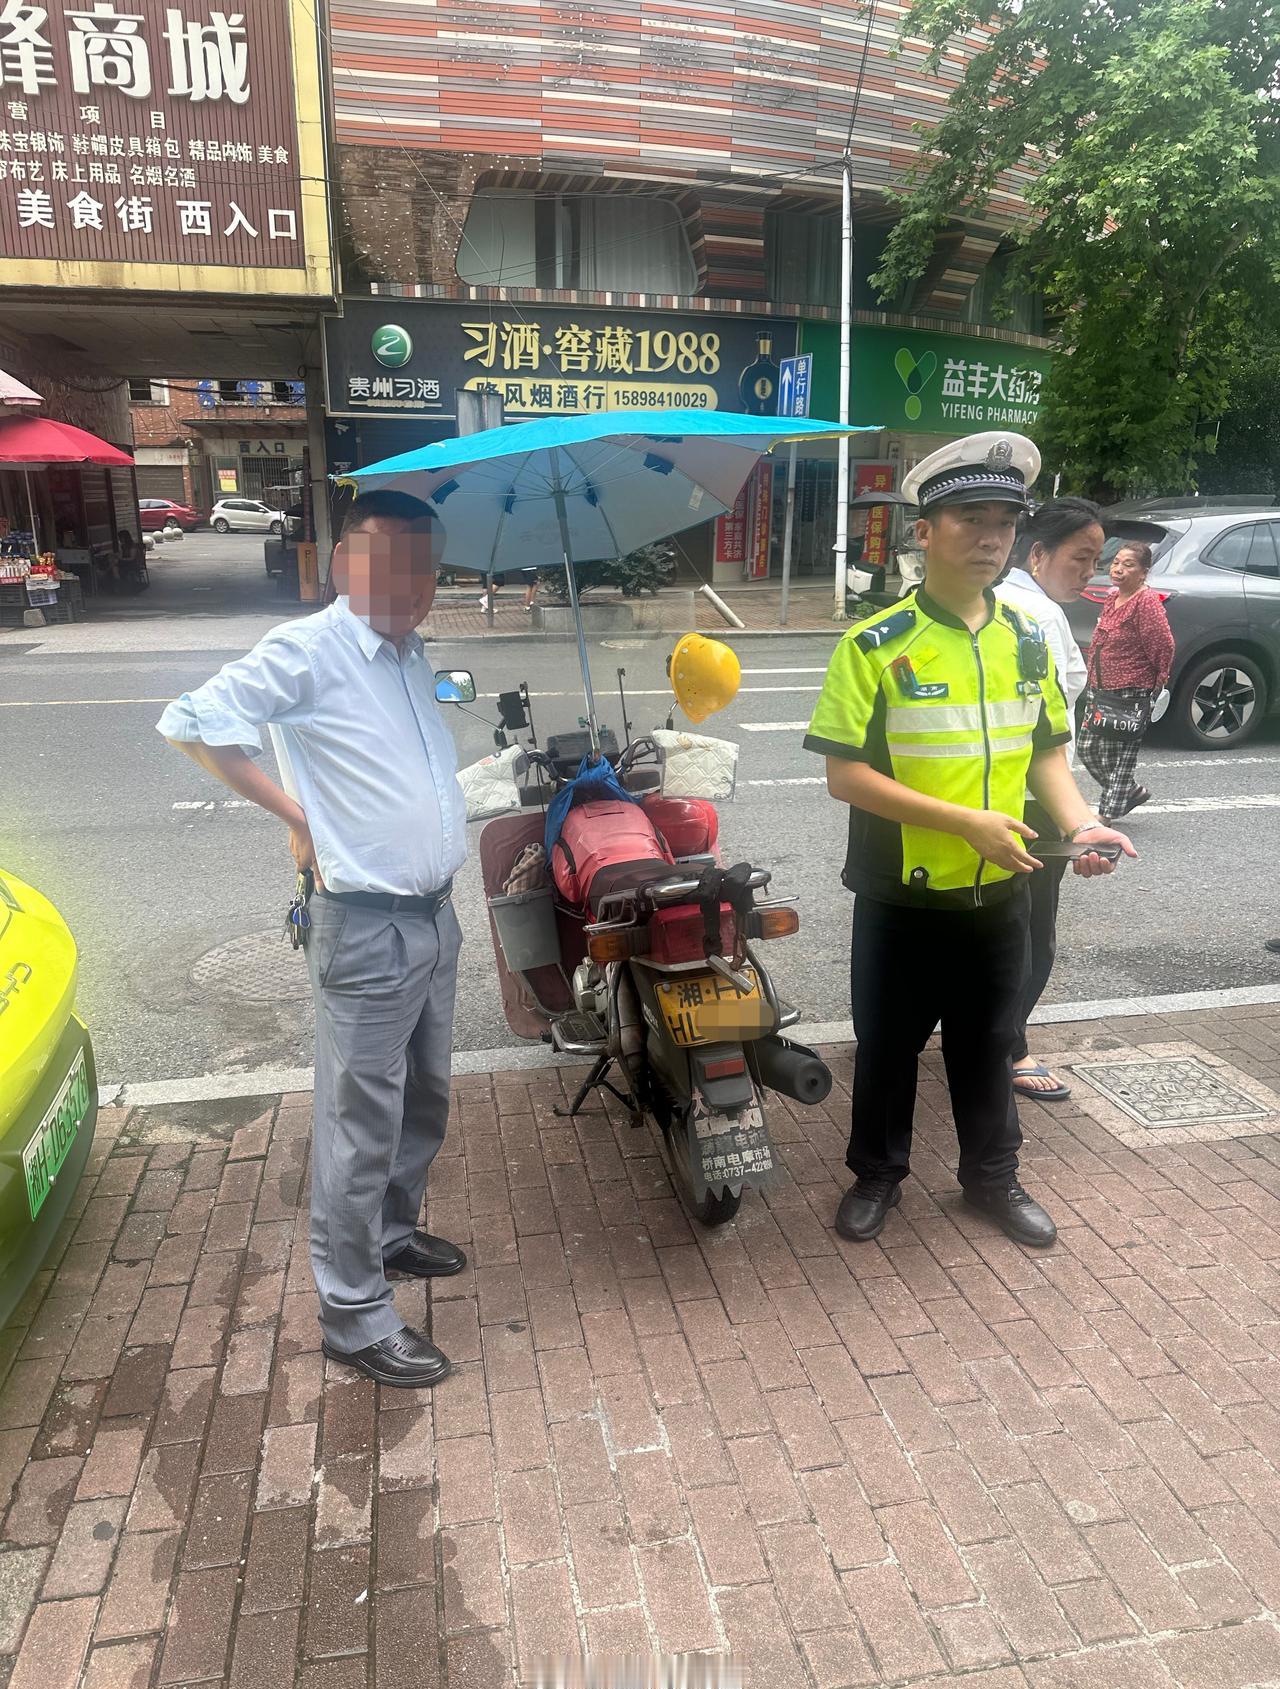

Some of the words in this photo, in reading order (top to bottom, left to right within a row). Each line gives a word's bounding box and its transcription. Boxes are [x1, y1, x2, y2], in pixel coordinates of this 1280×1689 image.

[72, 133, 181, 159] 鞋帽皮具箱包
[188, 138, 252, 163] 精品内饰
[258, 145, 289, 164] 美食
[52, 160, 121, 184] 床上用品
[129, 164, 196, 188] 名烟名酒
[348, 376, 440, 399] 贵州习酒
[613, 389, 708, 409] 15898410029
[941, 402, 983, 420] YIFENG
[987, 406, 1038, 424] PHARMACY
